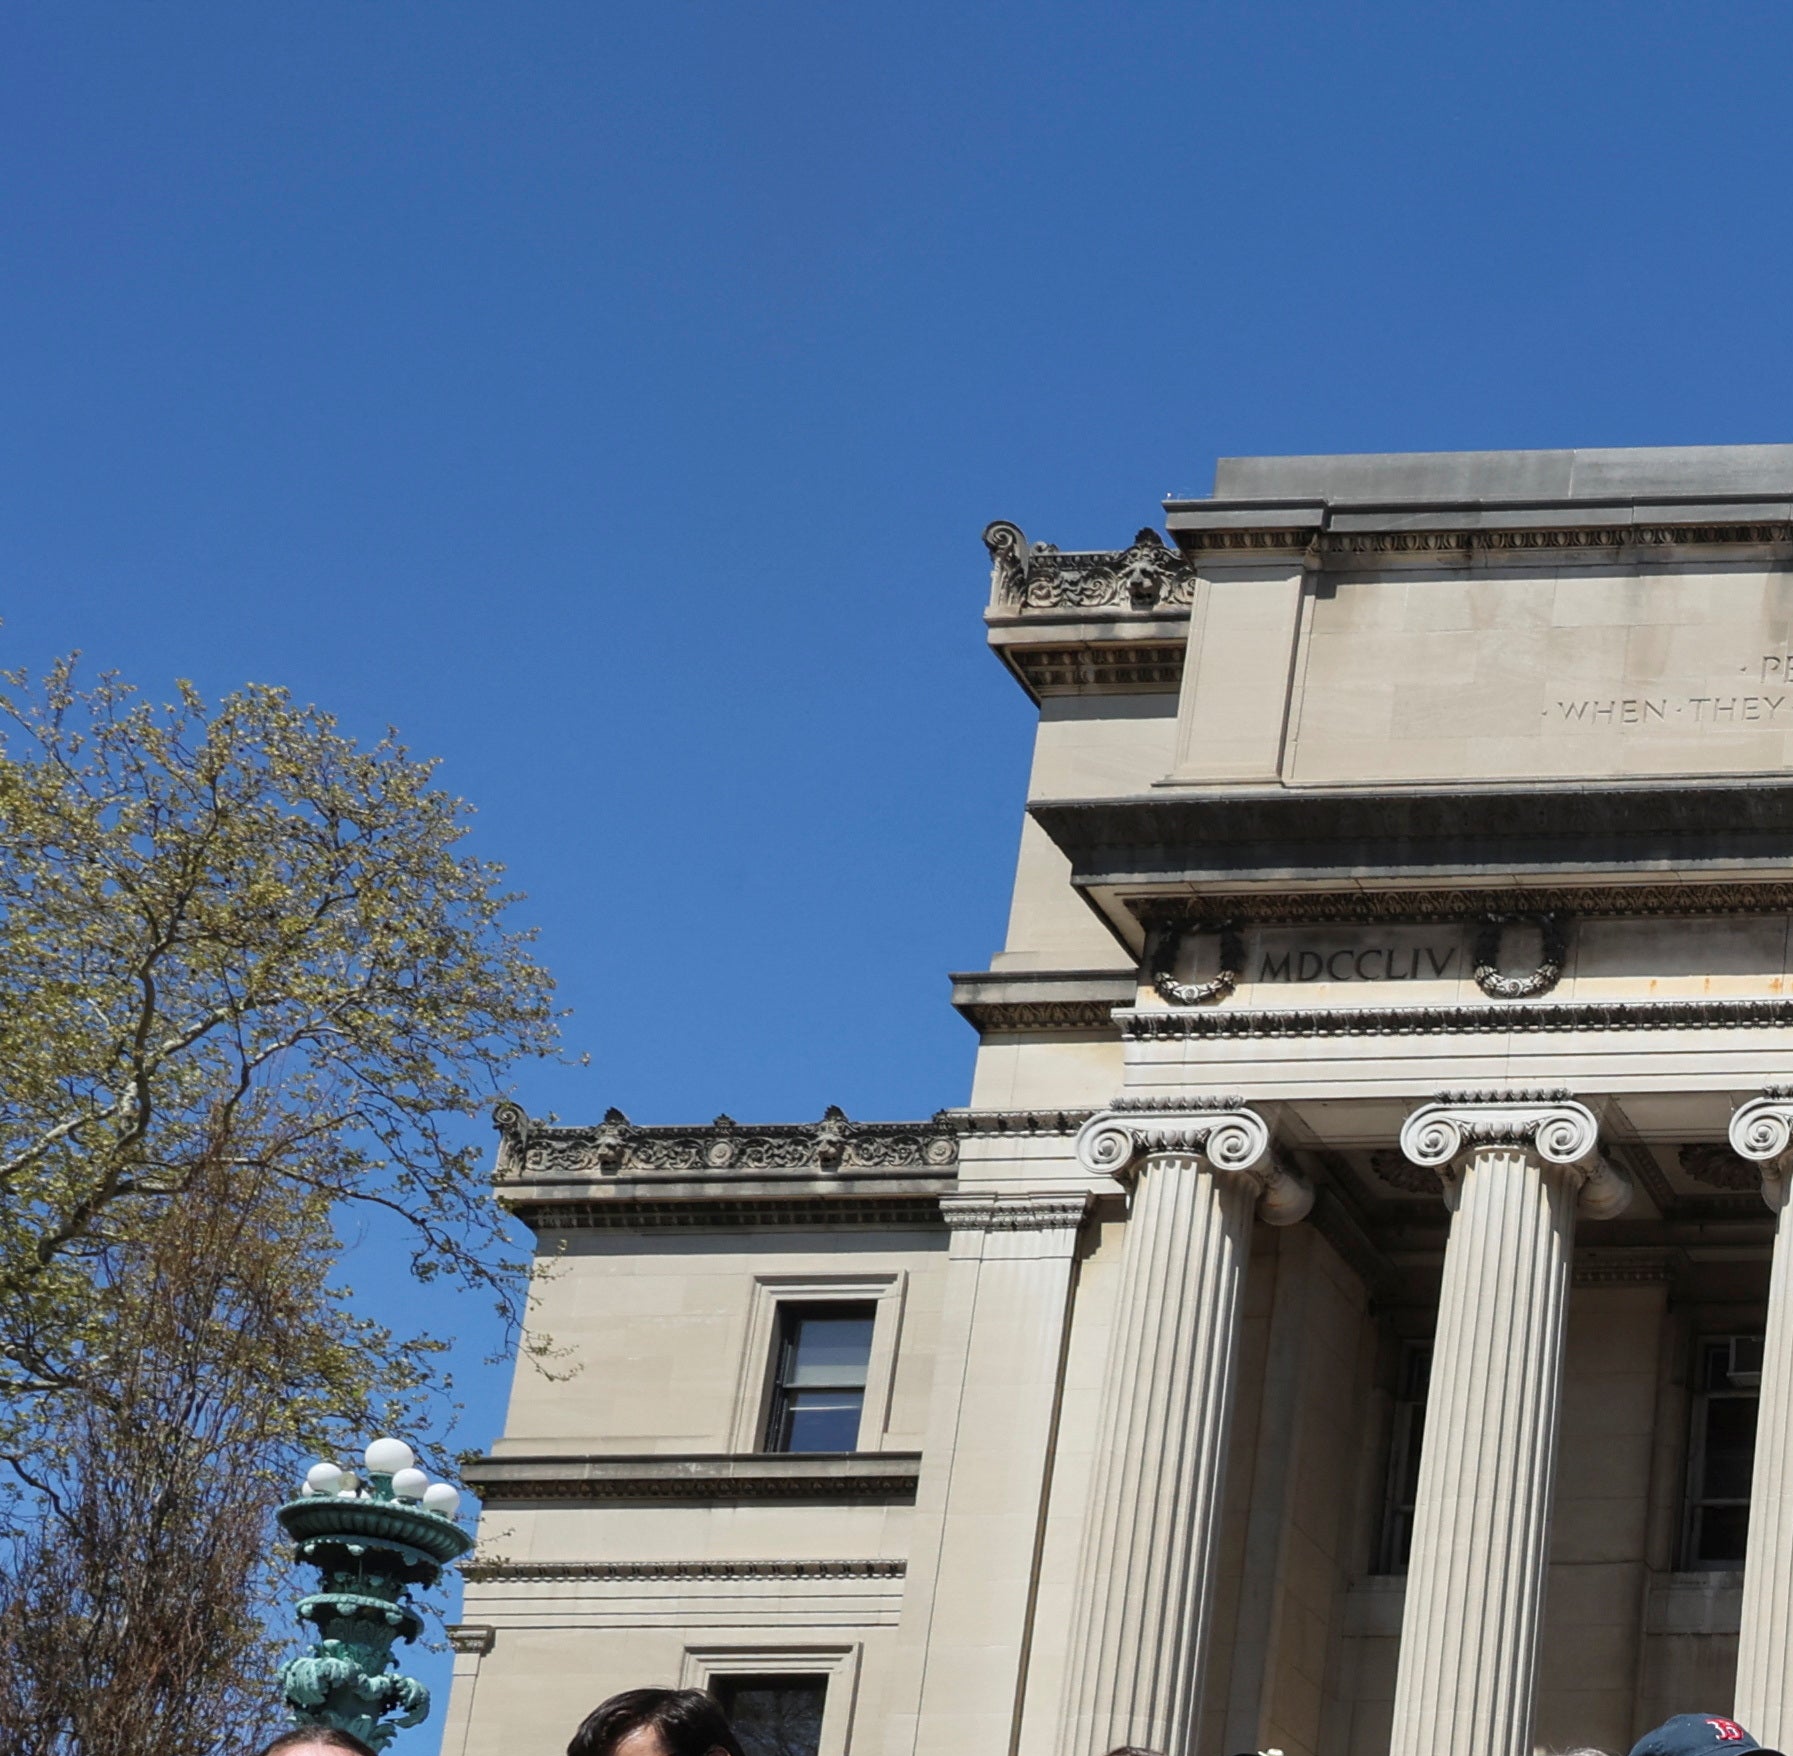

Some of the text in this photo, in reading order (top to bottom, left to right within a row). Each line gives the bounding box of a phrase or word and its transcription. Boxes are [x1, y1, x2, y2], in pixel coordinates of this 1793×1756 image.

[1557, 699, 1668, 724] WHEN
[1689, 696, 1786, 722] THEY
[1260, 948, 1455, 982] MDCCLIV
